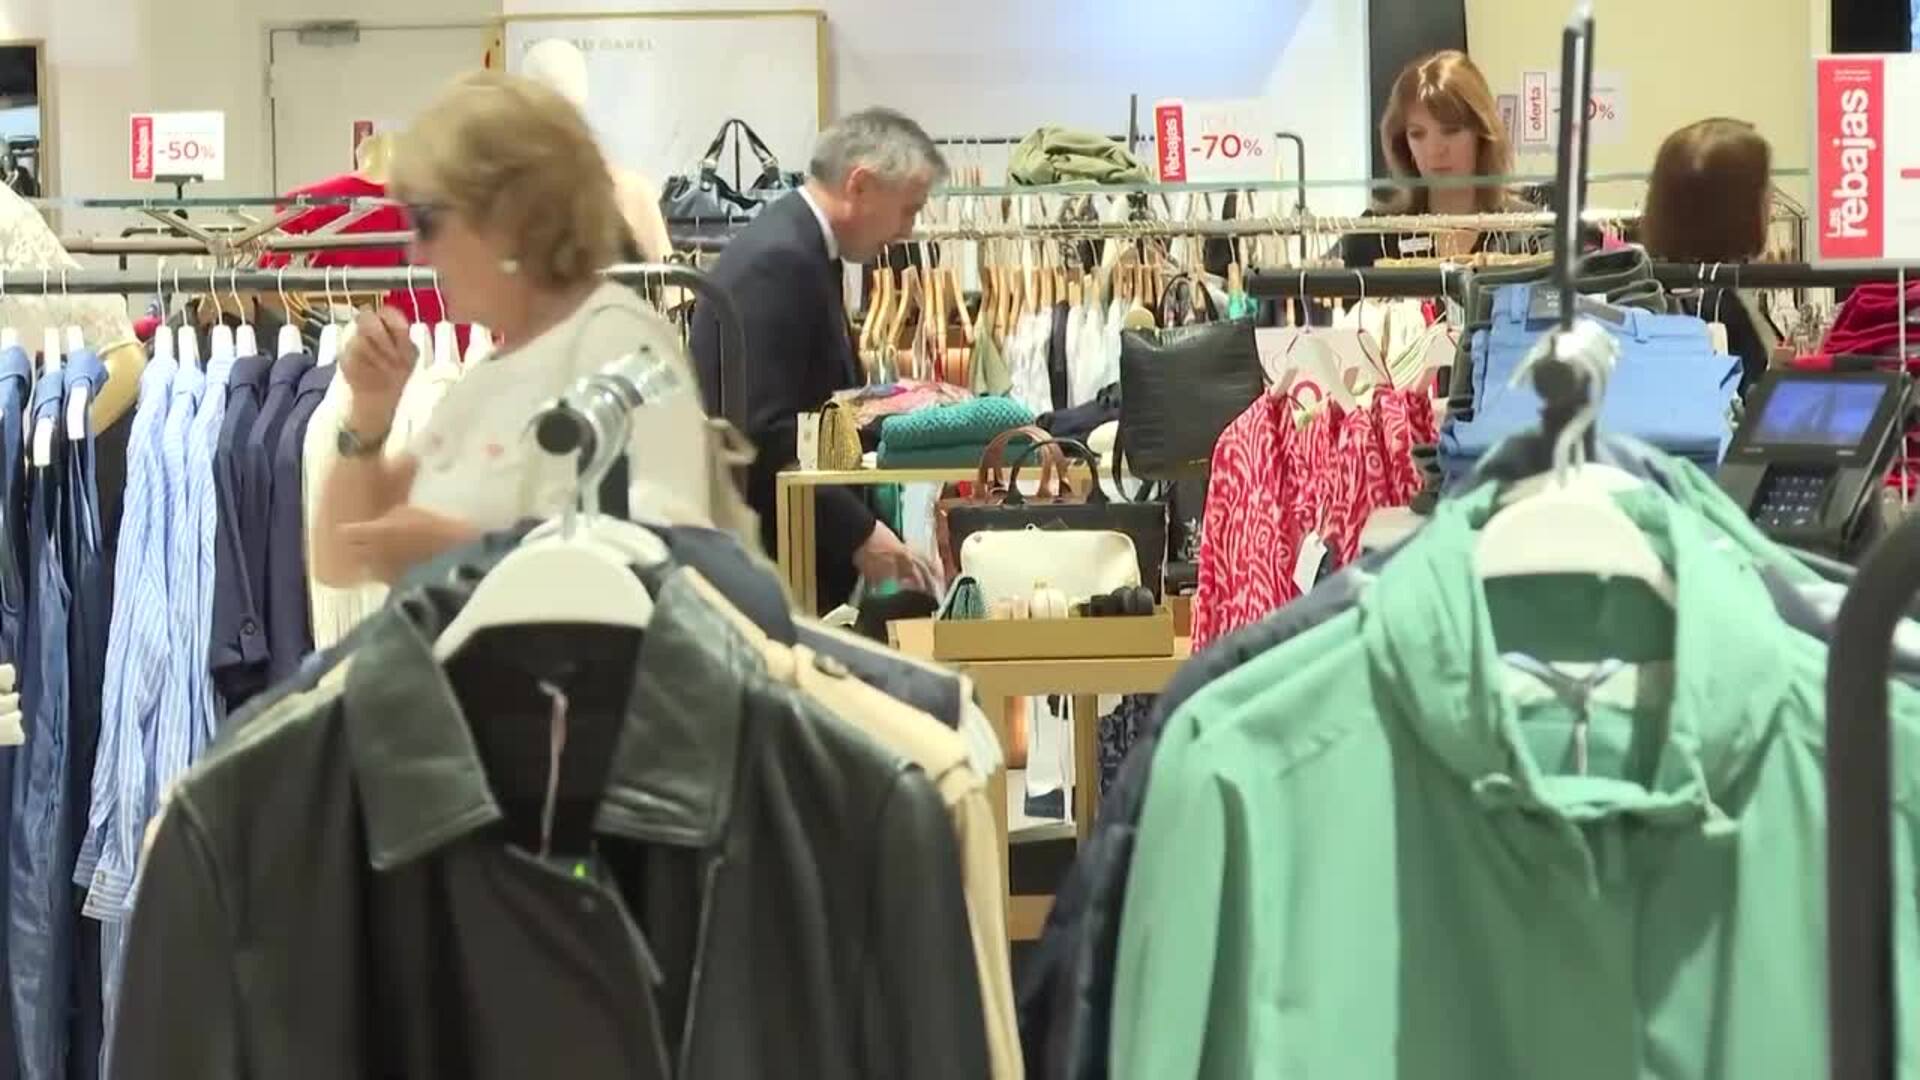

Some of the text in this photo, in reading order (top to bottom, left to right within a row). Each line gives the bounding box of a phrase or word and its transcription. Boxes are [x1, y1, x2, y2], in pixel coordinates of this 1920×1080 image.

[1529, 86, 1542, 131] oferta
[157, 140, 216, 161] -50%
[1191, 133, 1263, 160] -70%
[1830, 88, 1877, 238] rebajas
